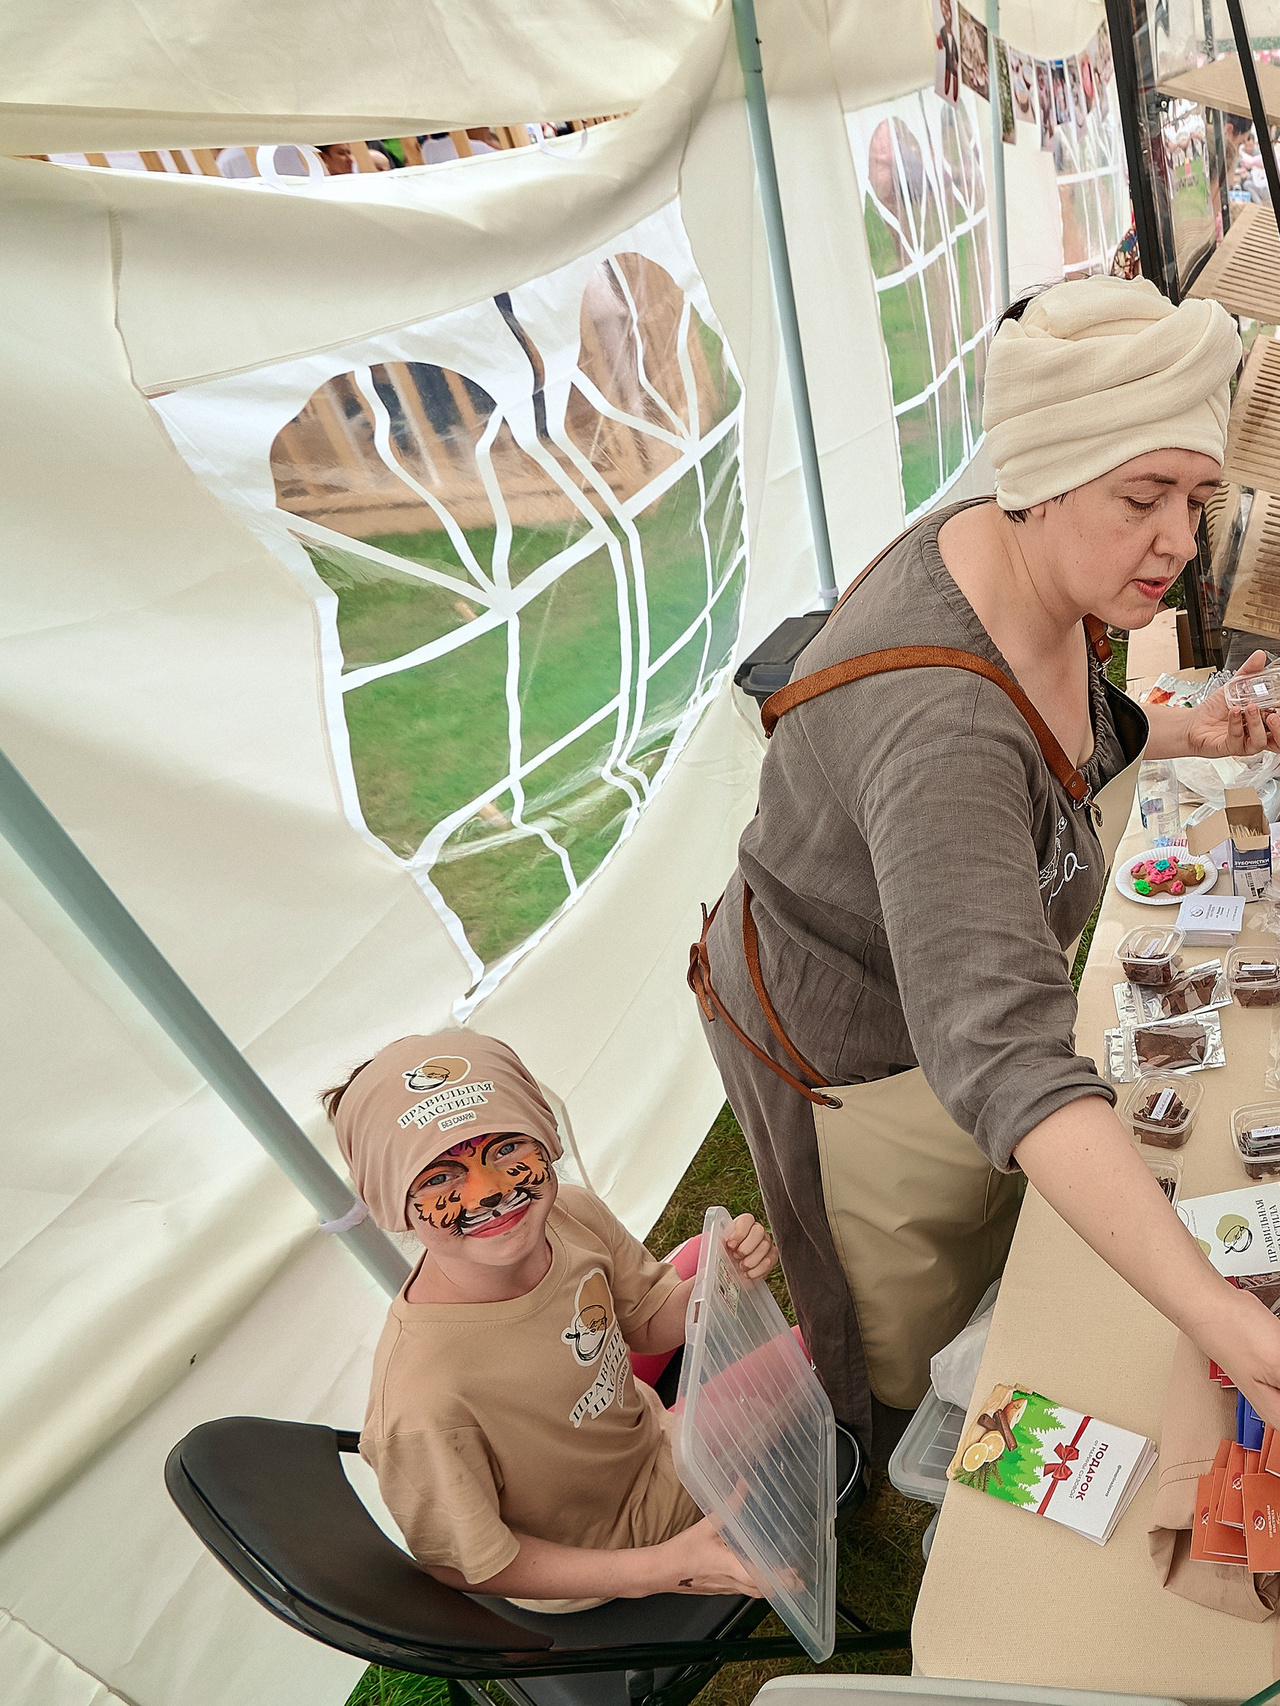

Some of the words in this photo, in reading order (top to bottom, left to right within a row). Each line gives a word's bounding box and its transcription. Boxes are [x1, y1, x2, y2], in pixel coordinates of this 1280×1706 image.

[400, 1083, 493, 1126] ПРАВИЛЬНАЯ
[418, 1094, 486, 1126] ПАСТИЛА
[441, 1120, 453, 1129] БЕЗ
[1255, 1199, 1278, 1263] ПРАВИЛЬНАЯ
[573, 1325, 621, 1420] ПРАВИЛЬ
[1076, 1443, 1109, 1501] ПОДАРОК
